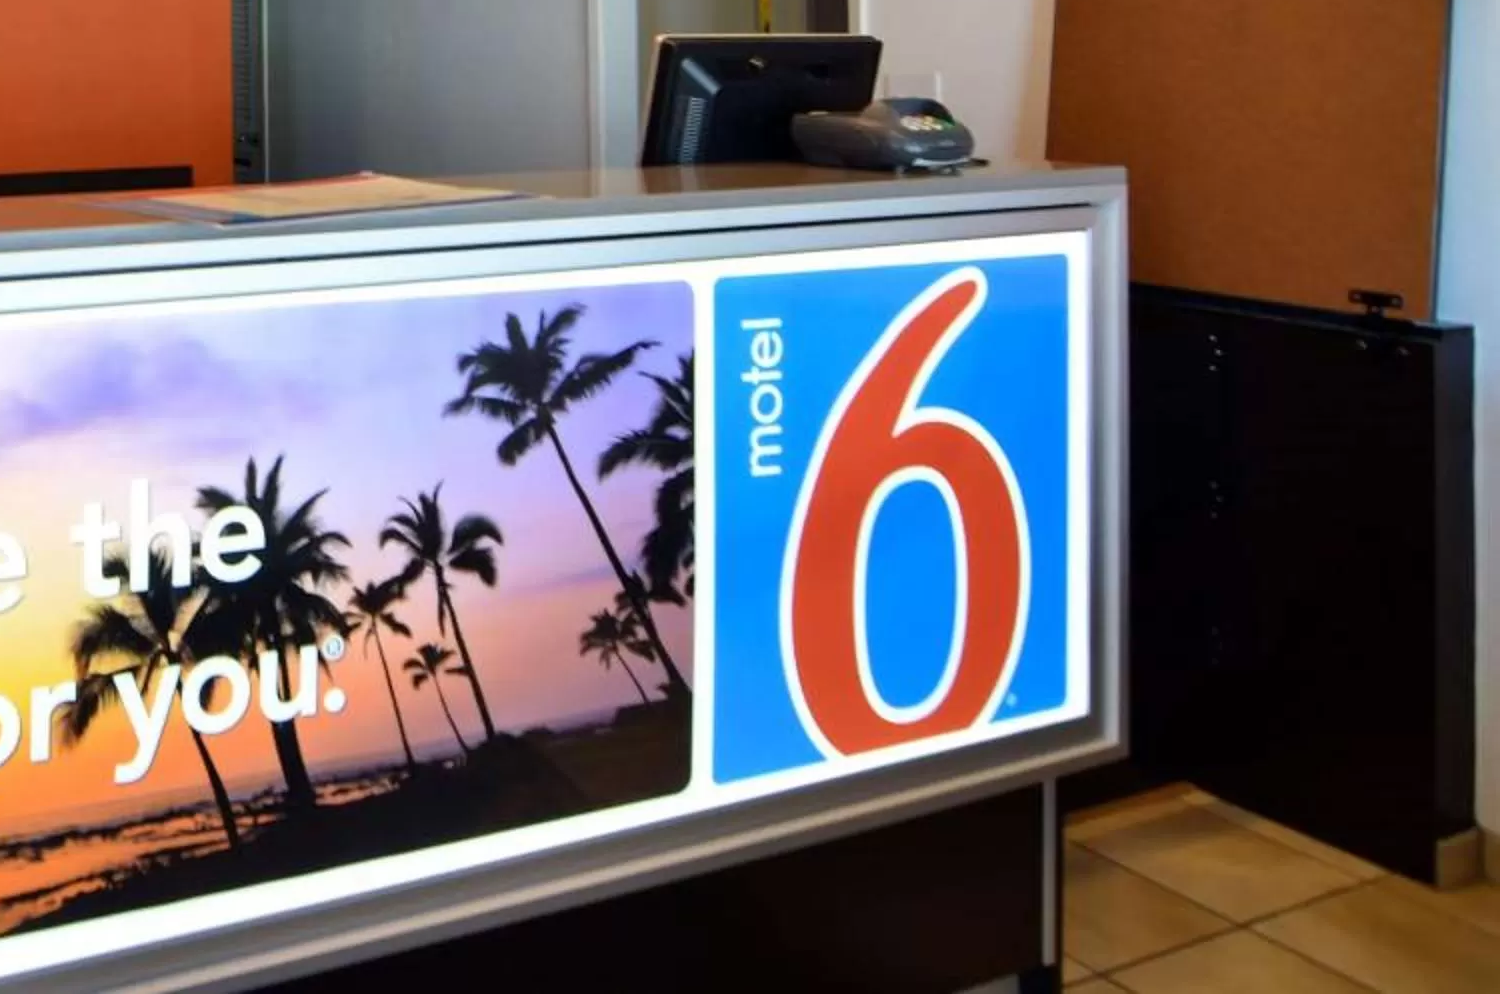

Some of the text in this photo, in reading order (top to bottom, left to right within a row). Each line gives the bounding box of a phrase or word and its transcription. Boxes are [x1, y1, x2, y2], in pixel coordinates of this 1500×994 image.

[740, 316, 784, 478] motel
[70, 478, 266, 599] the
[779, 265, 1032, 762] 6
